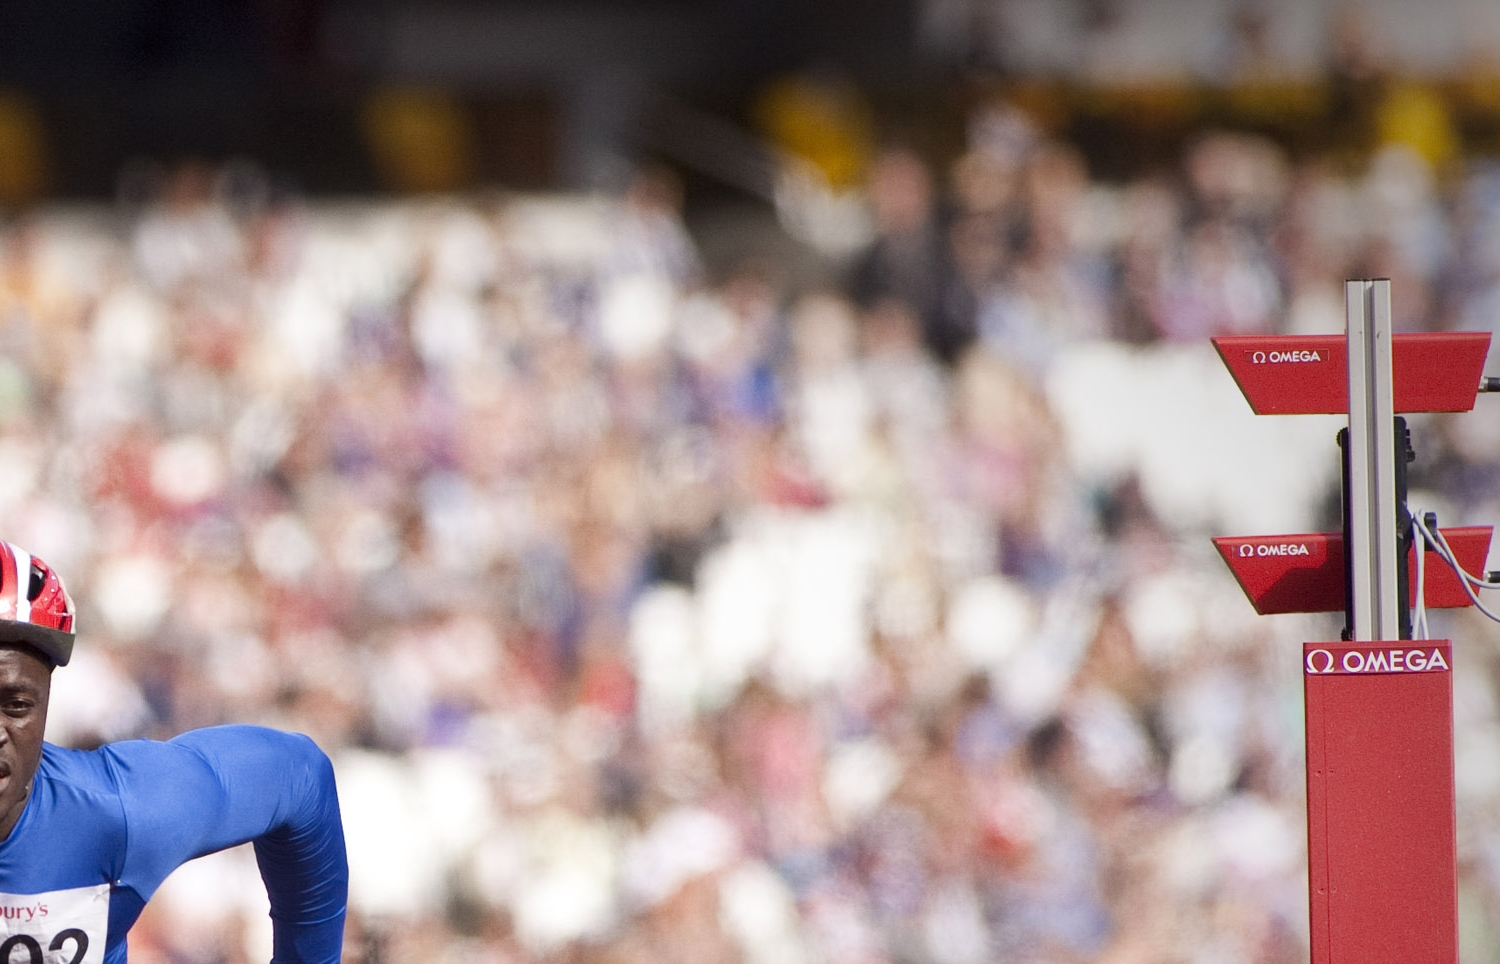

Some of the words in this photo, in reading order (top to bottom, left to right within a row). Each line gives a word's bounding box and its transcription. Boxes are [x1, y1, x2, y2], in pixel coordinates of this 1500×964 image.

[1269, 350, 1321, 363] OMEGA
[1257, 543, 1309, 557] OMEGA
[1342, 648, 1449, 673] OMEGA
